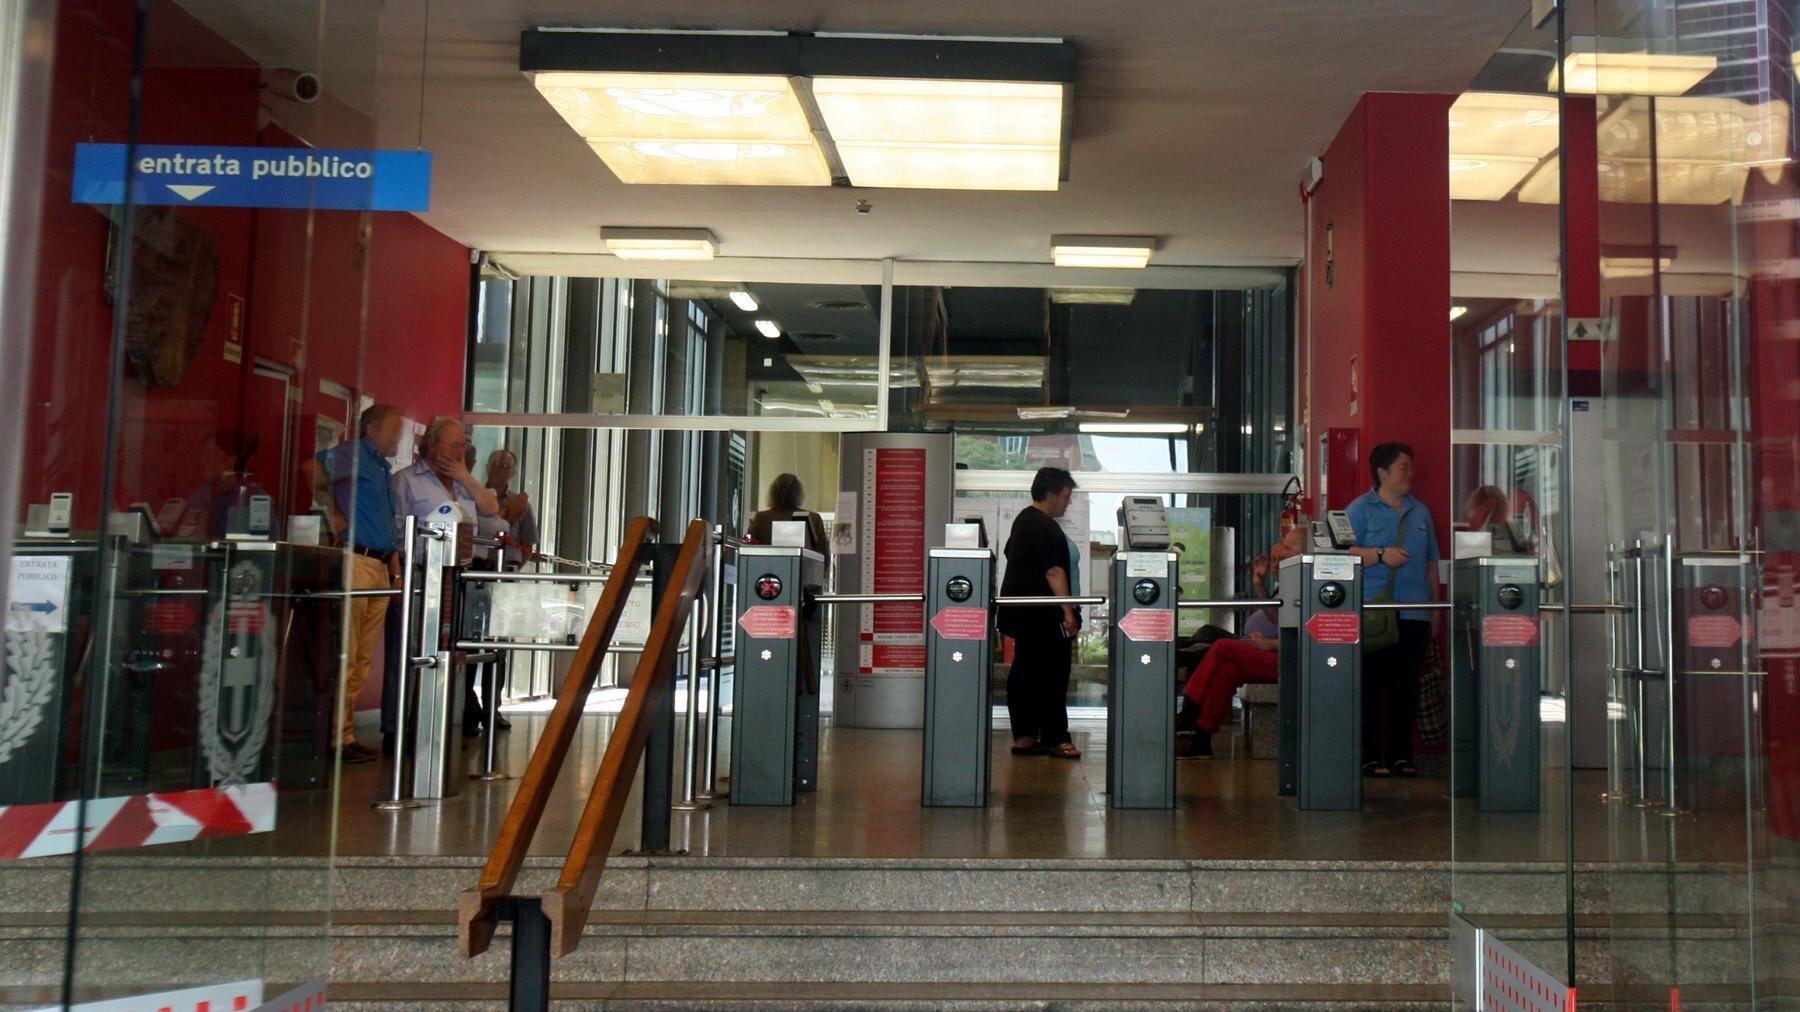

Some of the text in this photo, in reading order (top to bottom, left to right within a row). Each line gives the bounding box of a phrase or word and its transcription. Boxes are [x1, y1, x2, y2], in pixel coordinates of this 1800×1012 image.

[138, 153, 372, 180] entrata pubblico
[19, 560, 57, 569] ENTRATA
[17, 573, 58, 581] PUBBLICO
